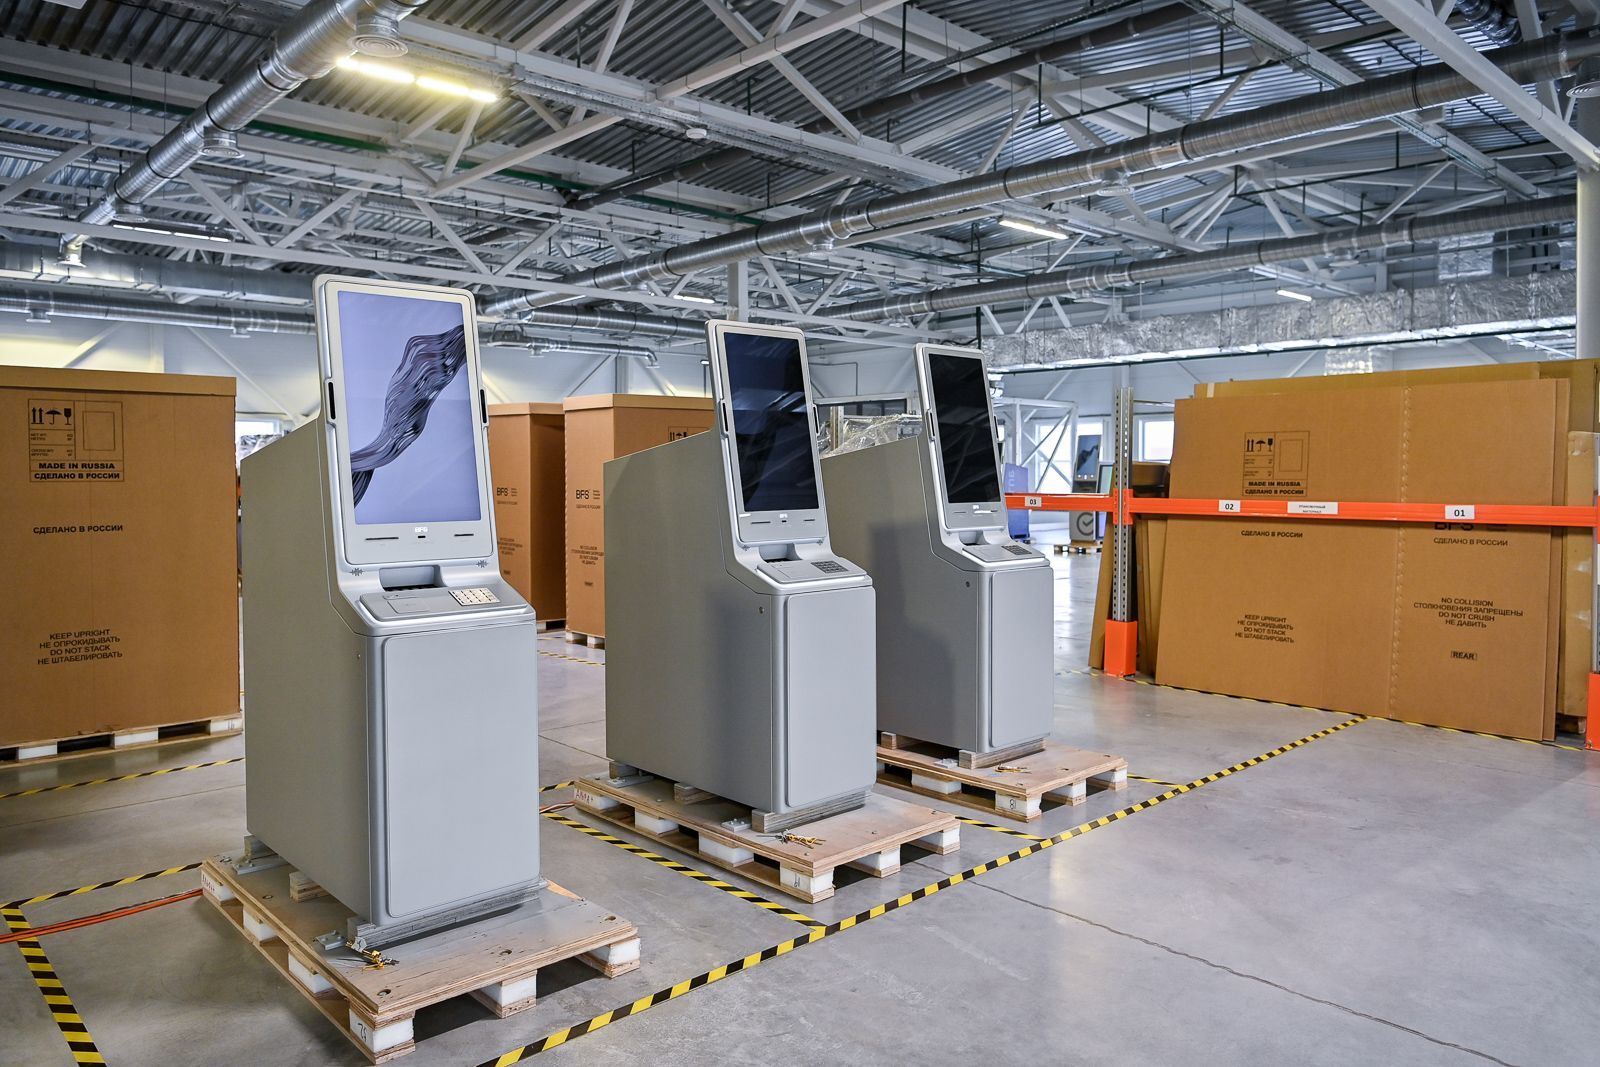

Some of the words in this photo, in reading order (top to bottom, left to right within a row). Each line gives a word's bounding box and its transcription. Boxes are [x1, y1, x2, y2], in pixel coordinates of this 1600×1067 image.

[38, 462, 66, 470] MADE
[68, 462, 79, 470] IN
[81, 462, 116, 470] RUSSIA
[34, 472, 76, 480] СДЕЛАНО
[496, 487, 509, 497] BFS
[575, 489, 590, 500] BFS
[1454, 509, 1465, 517] 01
[33, 526, 77, 535] СДЕЛАНО
[87, 524, 123, 532] РОССИИ
[1454, 598, 1494, 607] COLLISION
[1413, 602, 1473, 613] СТОЛКНОВЕНИЯ
[1473, 607, 1524, 617] ЗАПРЕЩЕНЫ
[1456, 620, 1487, 629] ДАВИТЬ
[49, 631, 73, 640] KEEP
[73, 628, 111, 638] UPRIGHT
[39, 641, 52, 649] НЕ
[53, 635, 121, 648] ОПРОКИДЫВАТЬ
[64, 646, 82, 654] NOT
[84, 644, 111, 652] STACK
[37, 657, 50, 665] НЕ
[51, 651, 123, 664] ШТАБЕЛИРОВАТЬ
[1453, 651, 1475, 660] REAR
